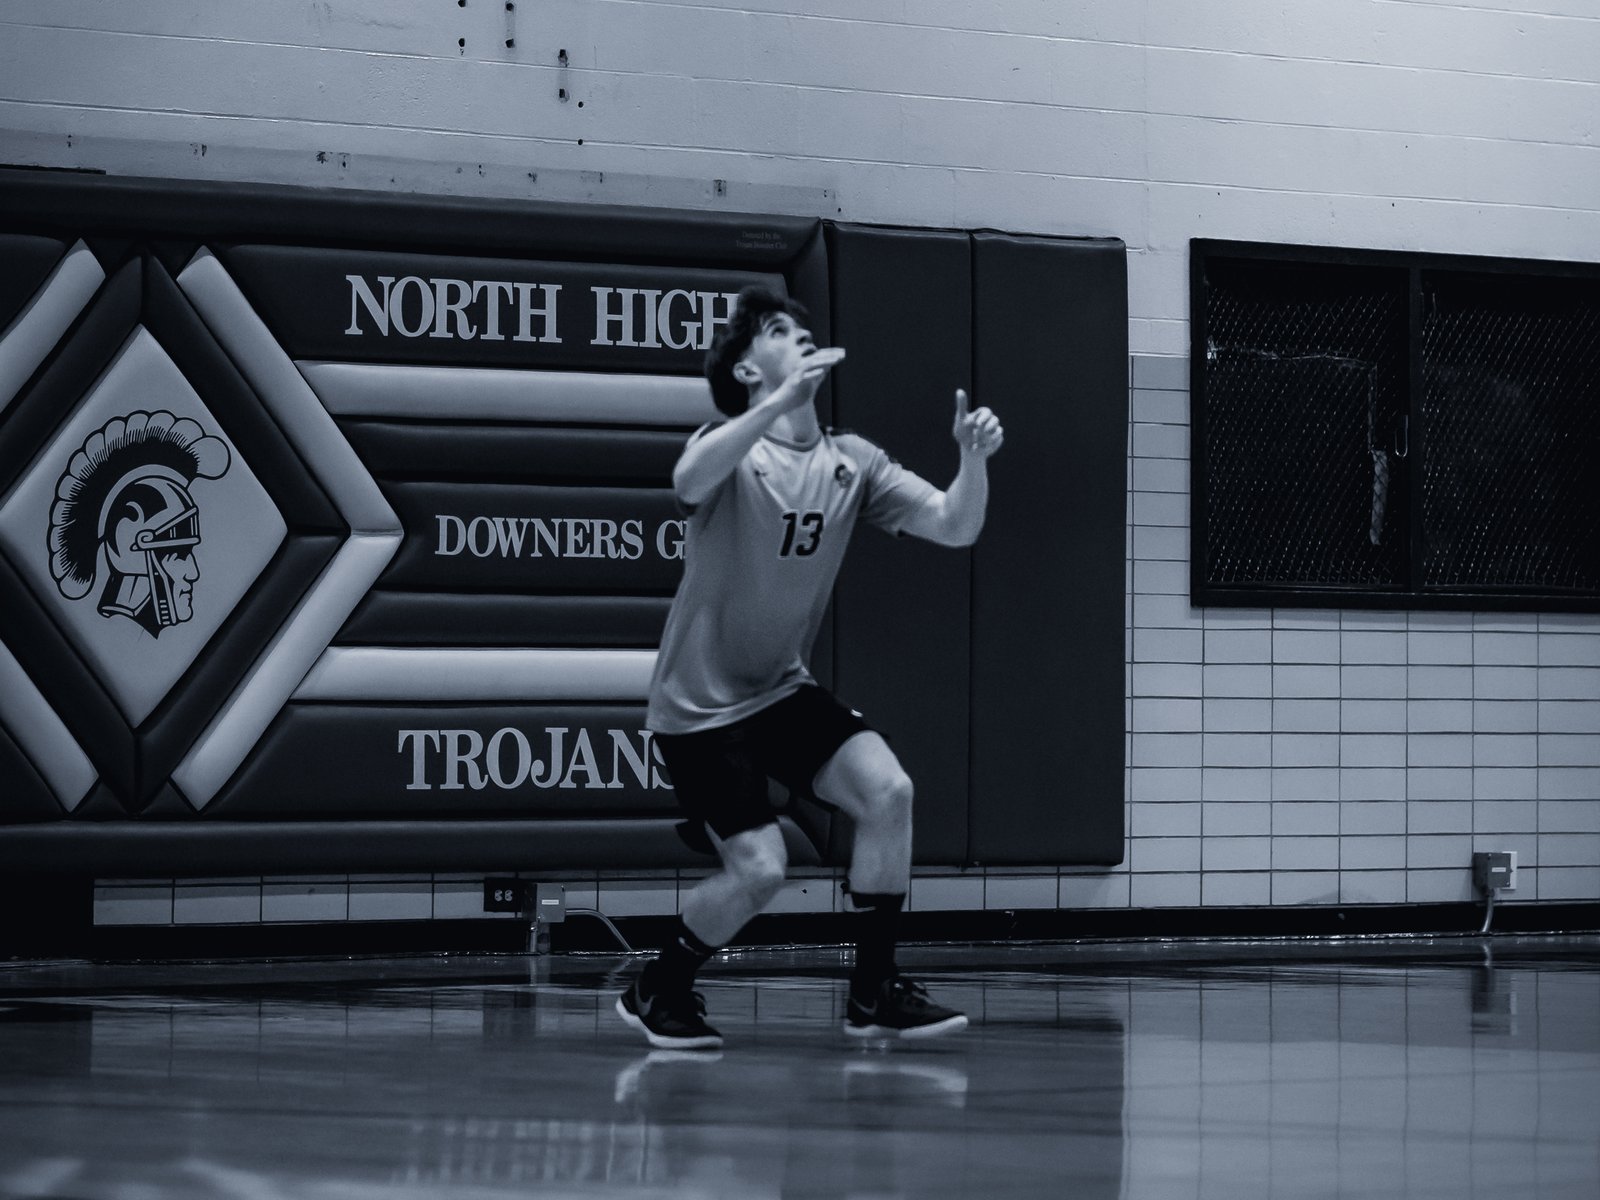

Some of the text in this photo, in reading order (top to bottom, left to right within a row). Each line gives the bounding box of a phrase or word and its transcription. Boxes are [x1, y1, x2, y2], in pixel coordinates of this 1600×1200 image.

[345, 275, 741, 350] NORTH HIGH
[435, 515, 644, 560] DOWNERS
[779, 511, 825, 558] 13
